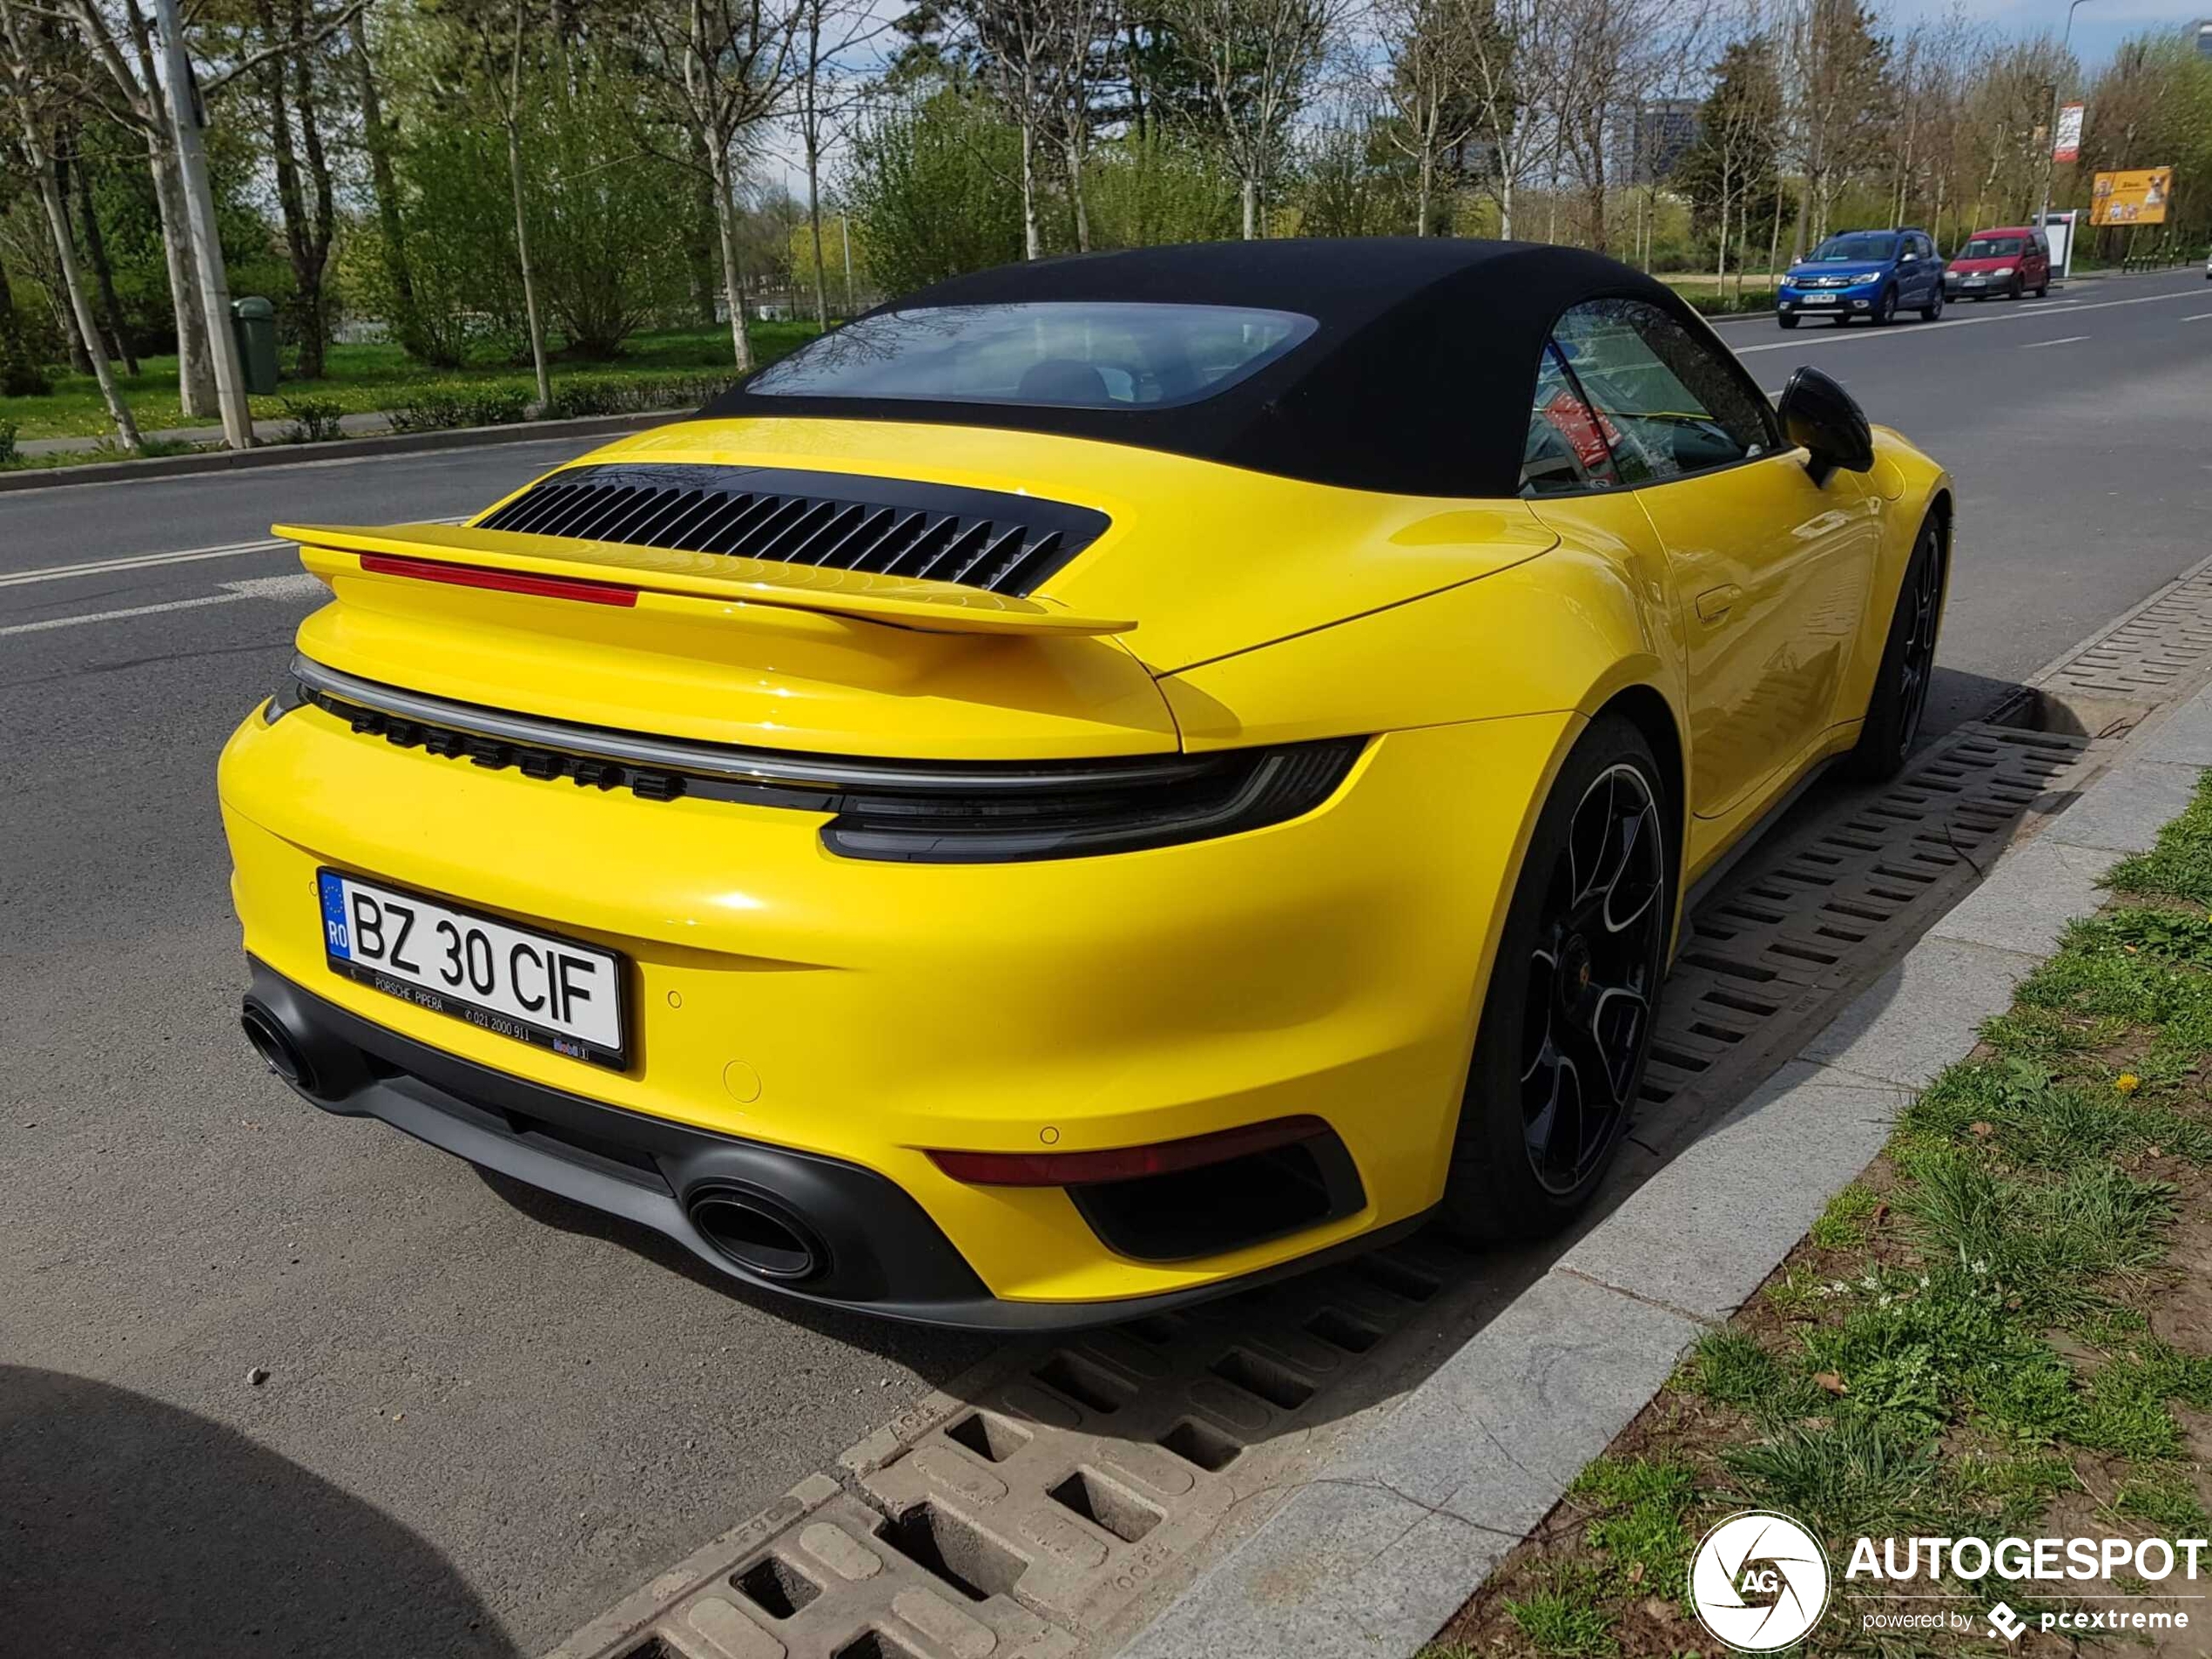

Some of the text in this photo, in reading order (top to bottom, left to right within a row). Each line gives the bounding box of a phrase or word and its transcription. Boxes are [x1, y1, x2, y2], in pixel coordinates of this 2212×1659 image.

[327, 921, 347, 948] RO
[352, 892, 595, 1023] BZ 30 CIF
[374, 977, 443, 1012] PORSCHE PIPERA
[474, 1011, 529, 1042] 021 2000 911
